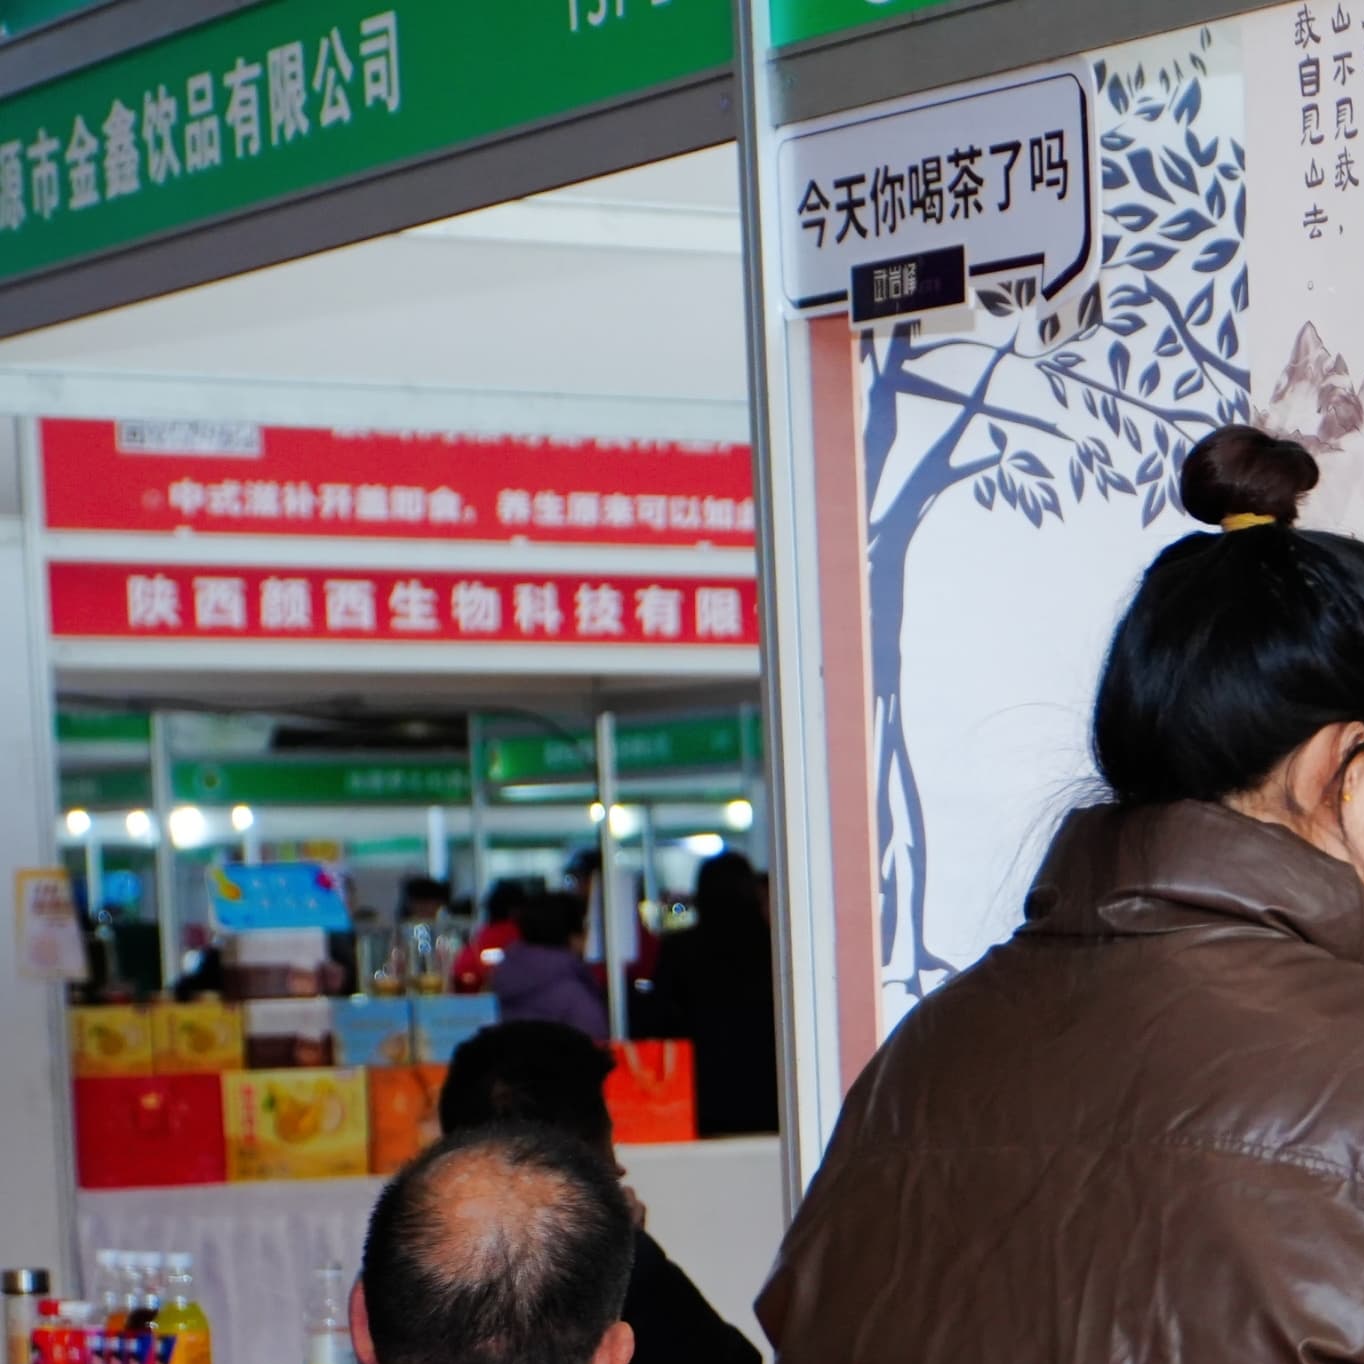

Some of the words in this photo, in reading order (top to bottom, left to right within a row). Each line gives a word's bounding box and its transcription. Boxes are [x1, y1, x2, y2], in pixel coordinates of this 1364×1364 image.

[798, 129, 1068, 248] 今天你喝茶了吗
